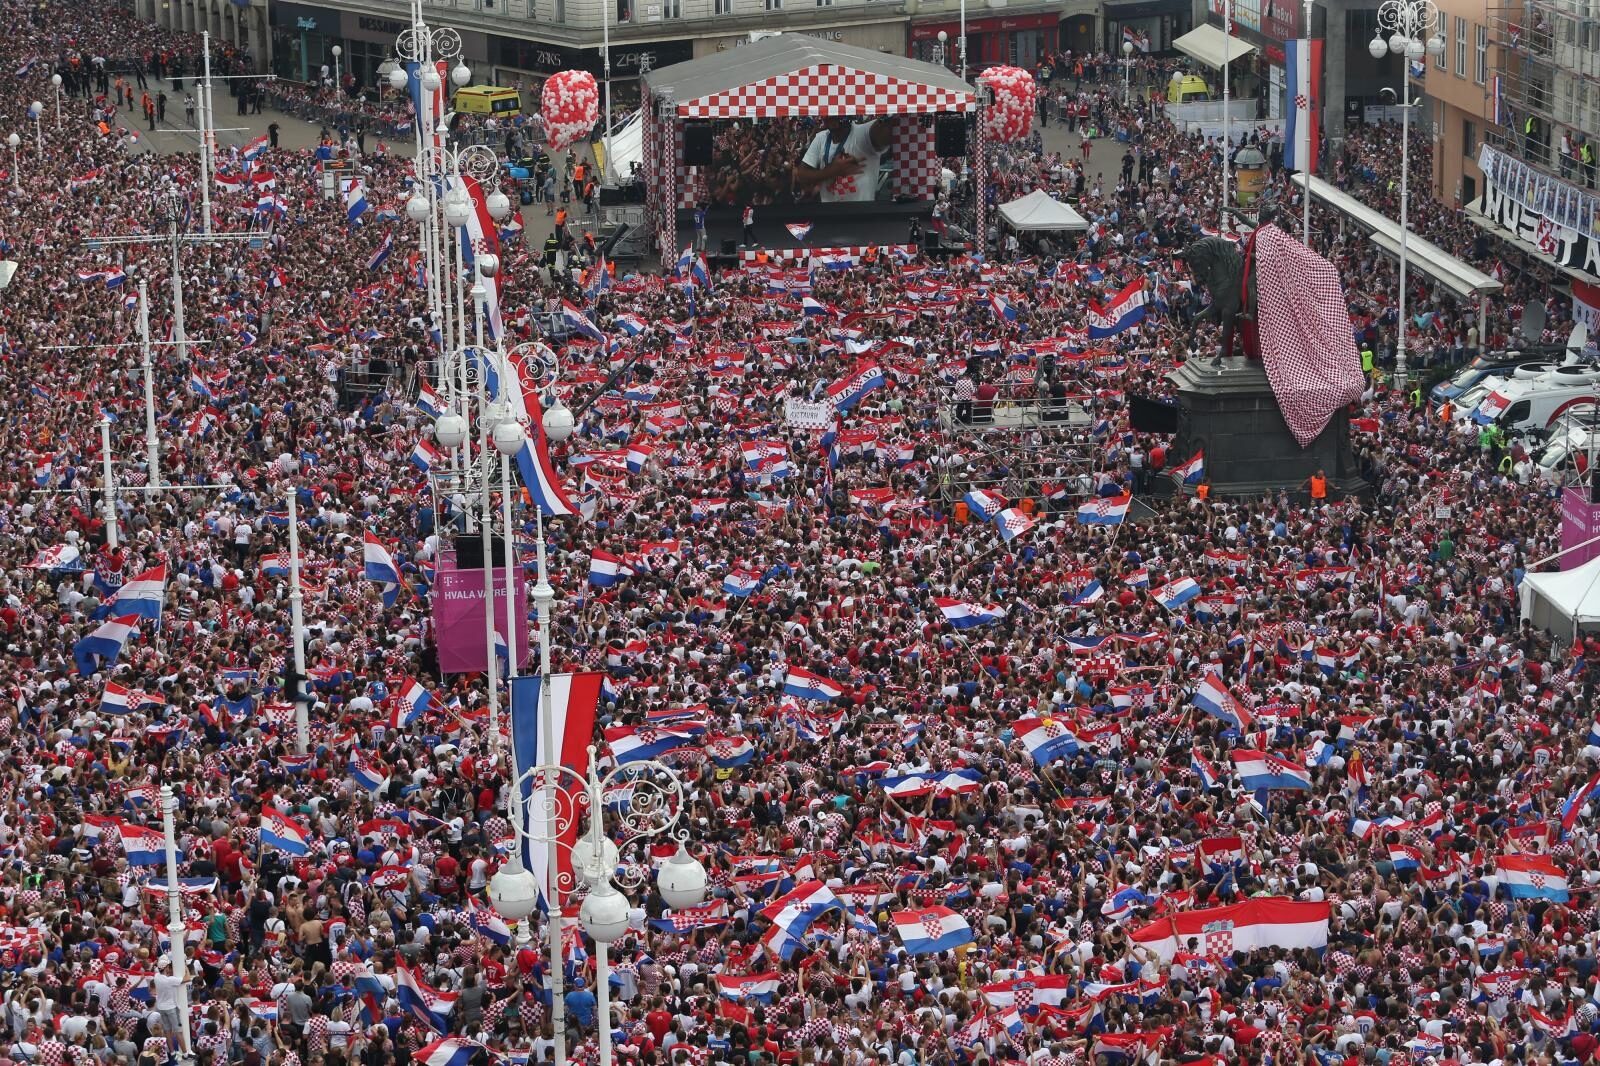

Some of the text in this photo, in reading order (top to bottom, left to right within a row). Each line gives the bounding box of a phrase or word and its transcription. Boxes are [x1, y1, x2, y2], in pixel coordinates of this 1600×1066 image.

[536, 50, 561, 66] ZAKS
[445, 590, 476, 600] HVALA
[1537, 756, 1546, 764] 17
[1360, 1024, 1369, 1034] 10
